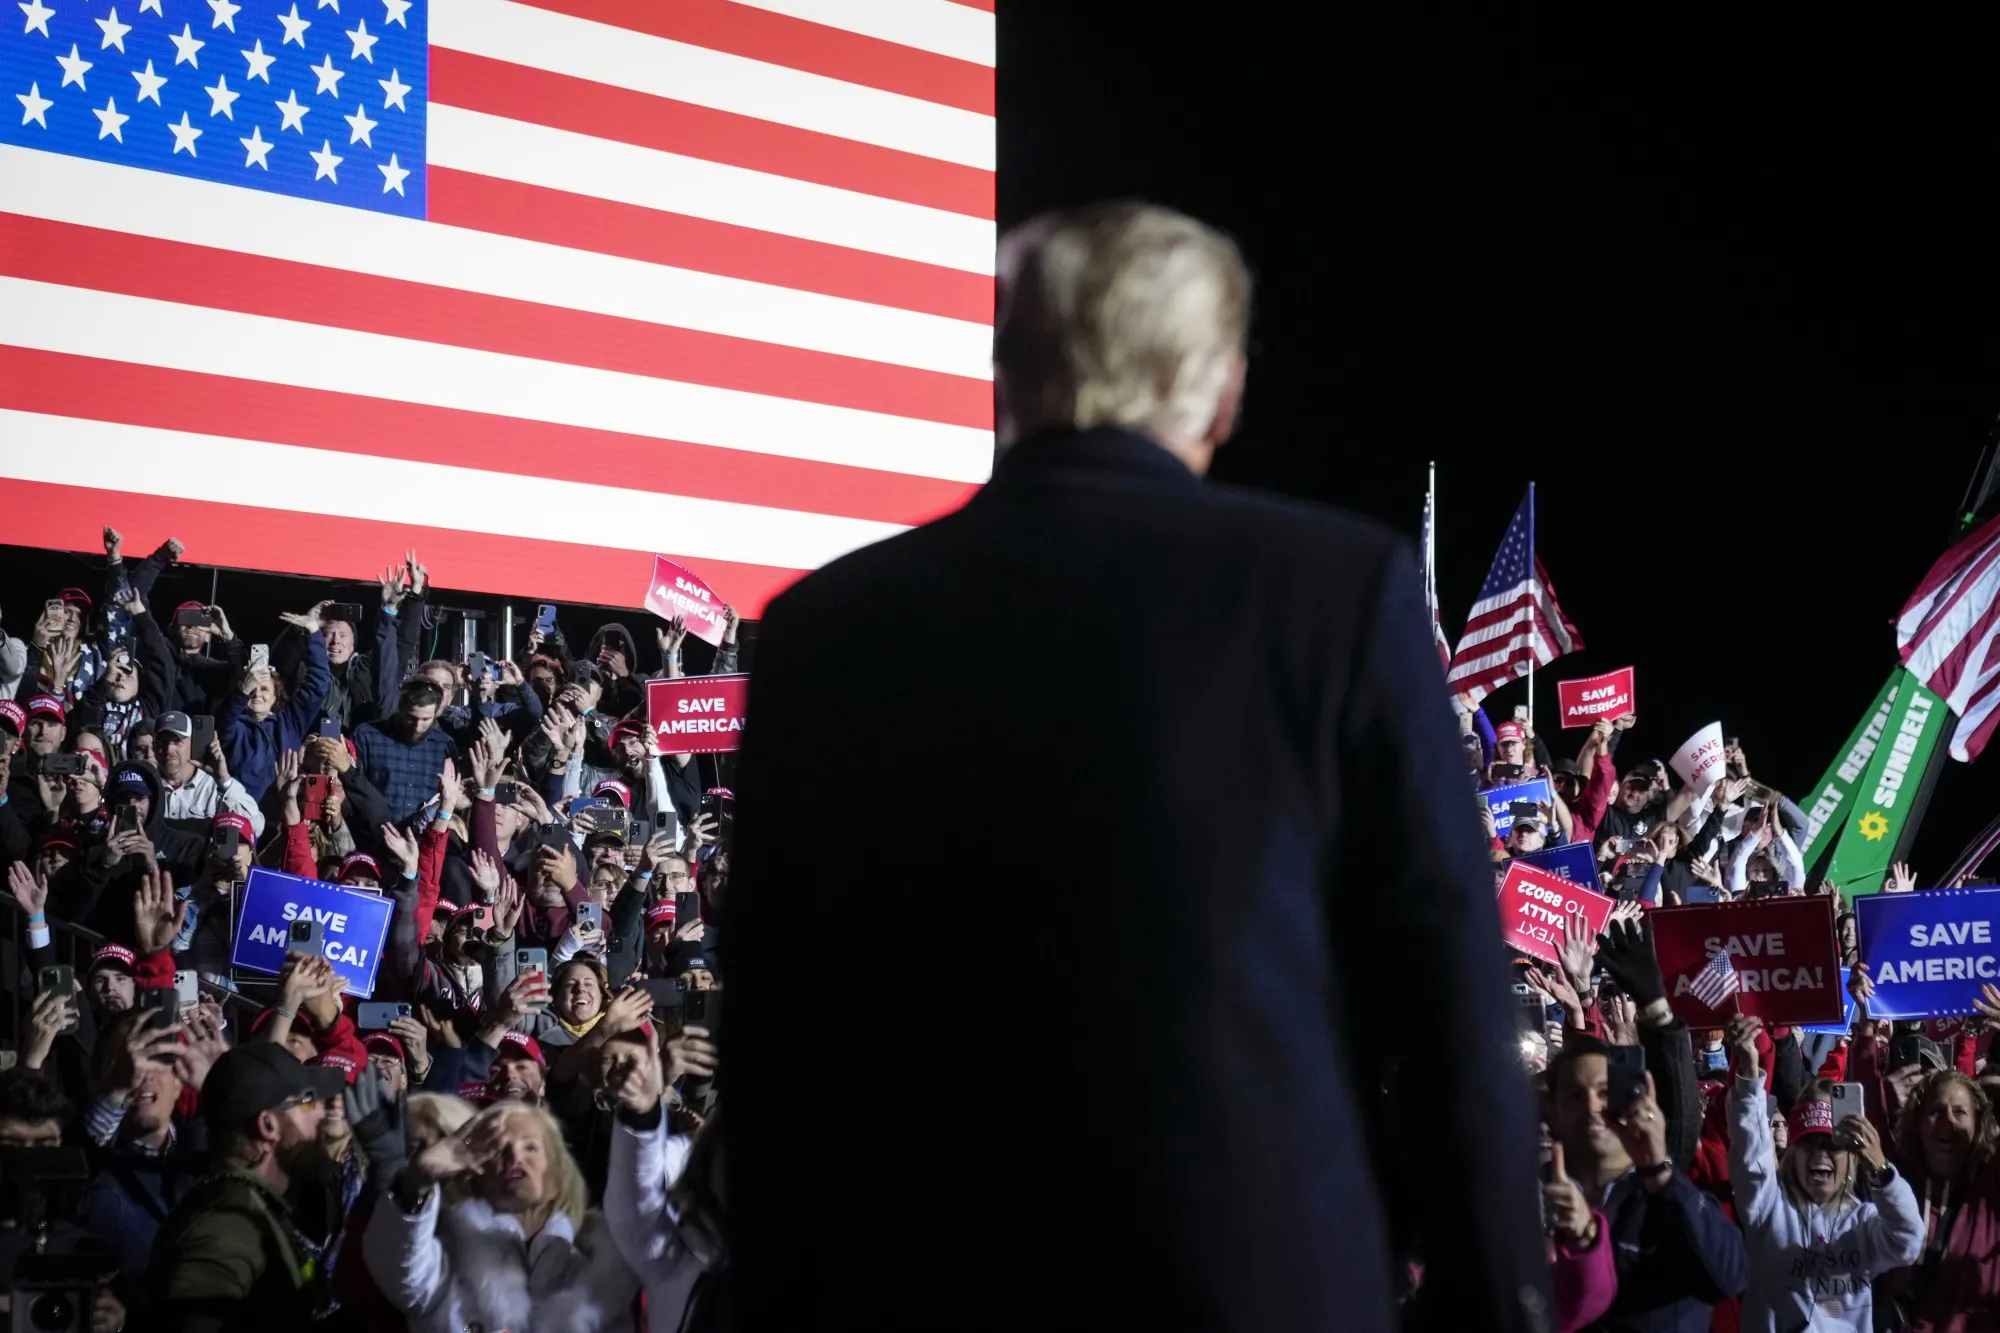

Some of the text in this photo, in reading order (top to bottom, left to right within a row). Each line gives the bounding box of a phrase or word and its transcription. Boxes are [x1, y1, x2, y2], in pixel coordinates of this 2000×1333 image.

[675, 577, 711, 602] SAVE
[678, 698, 726, 714] SAVE
[1568, 693, 1628, 716] AMERICA!
[1582, 685, 1616, 702] SAVE
[1691, 739, 1719, 762] SAVE
[1873, 690, 1933, 809] SUNBELT
[600, 781, 628, 794] TRUMP
[1518, 880, 1564, 908] 88022
[282, 902, 348, 934] SAVE
[248, 924, 368, 968] AMCA!
[1516, 920, 1555, 946] TEXT
[1910, 921, 1992, 947] SAVE
[1704, 933, 1786, 960] SAVE
[1674, 966, 1824, 998] ARICA!
[1877, 955, 2000, 985] AMERIC
[1801, 1109, 1832, 1120] AMERI
[1804, 1118, 1833, 1128] GREA
